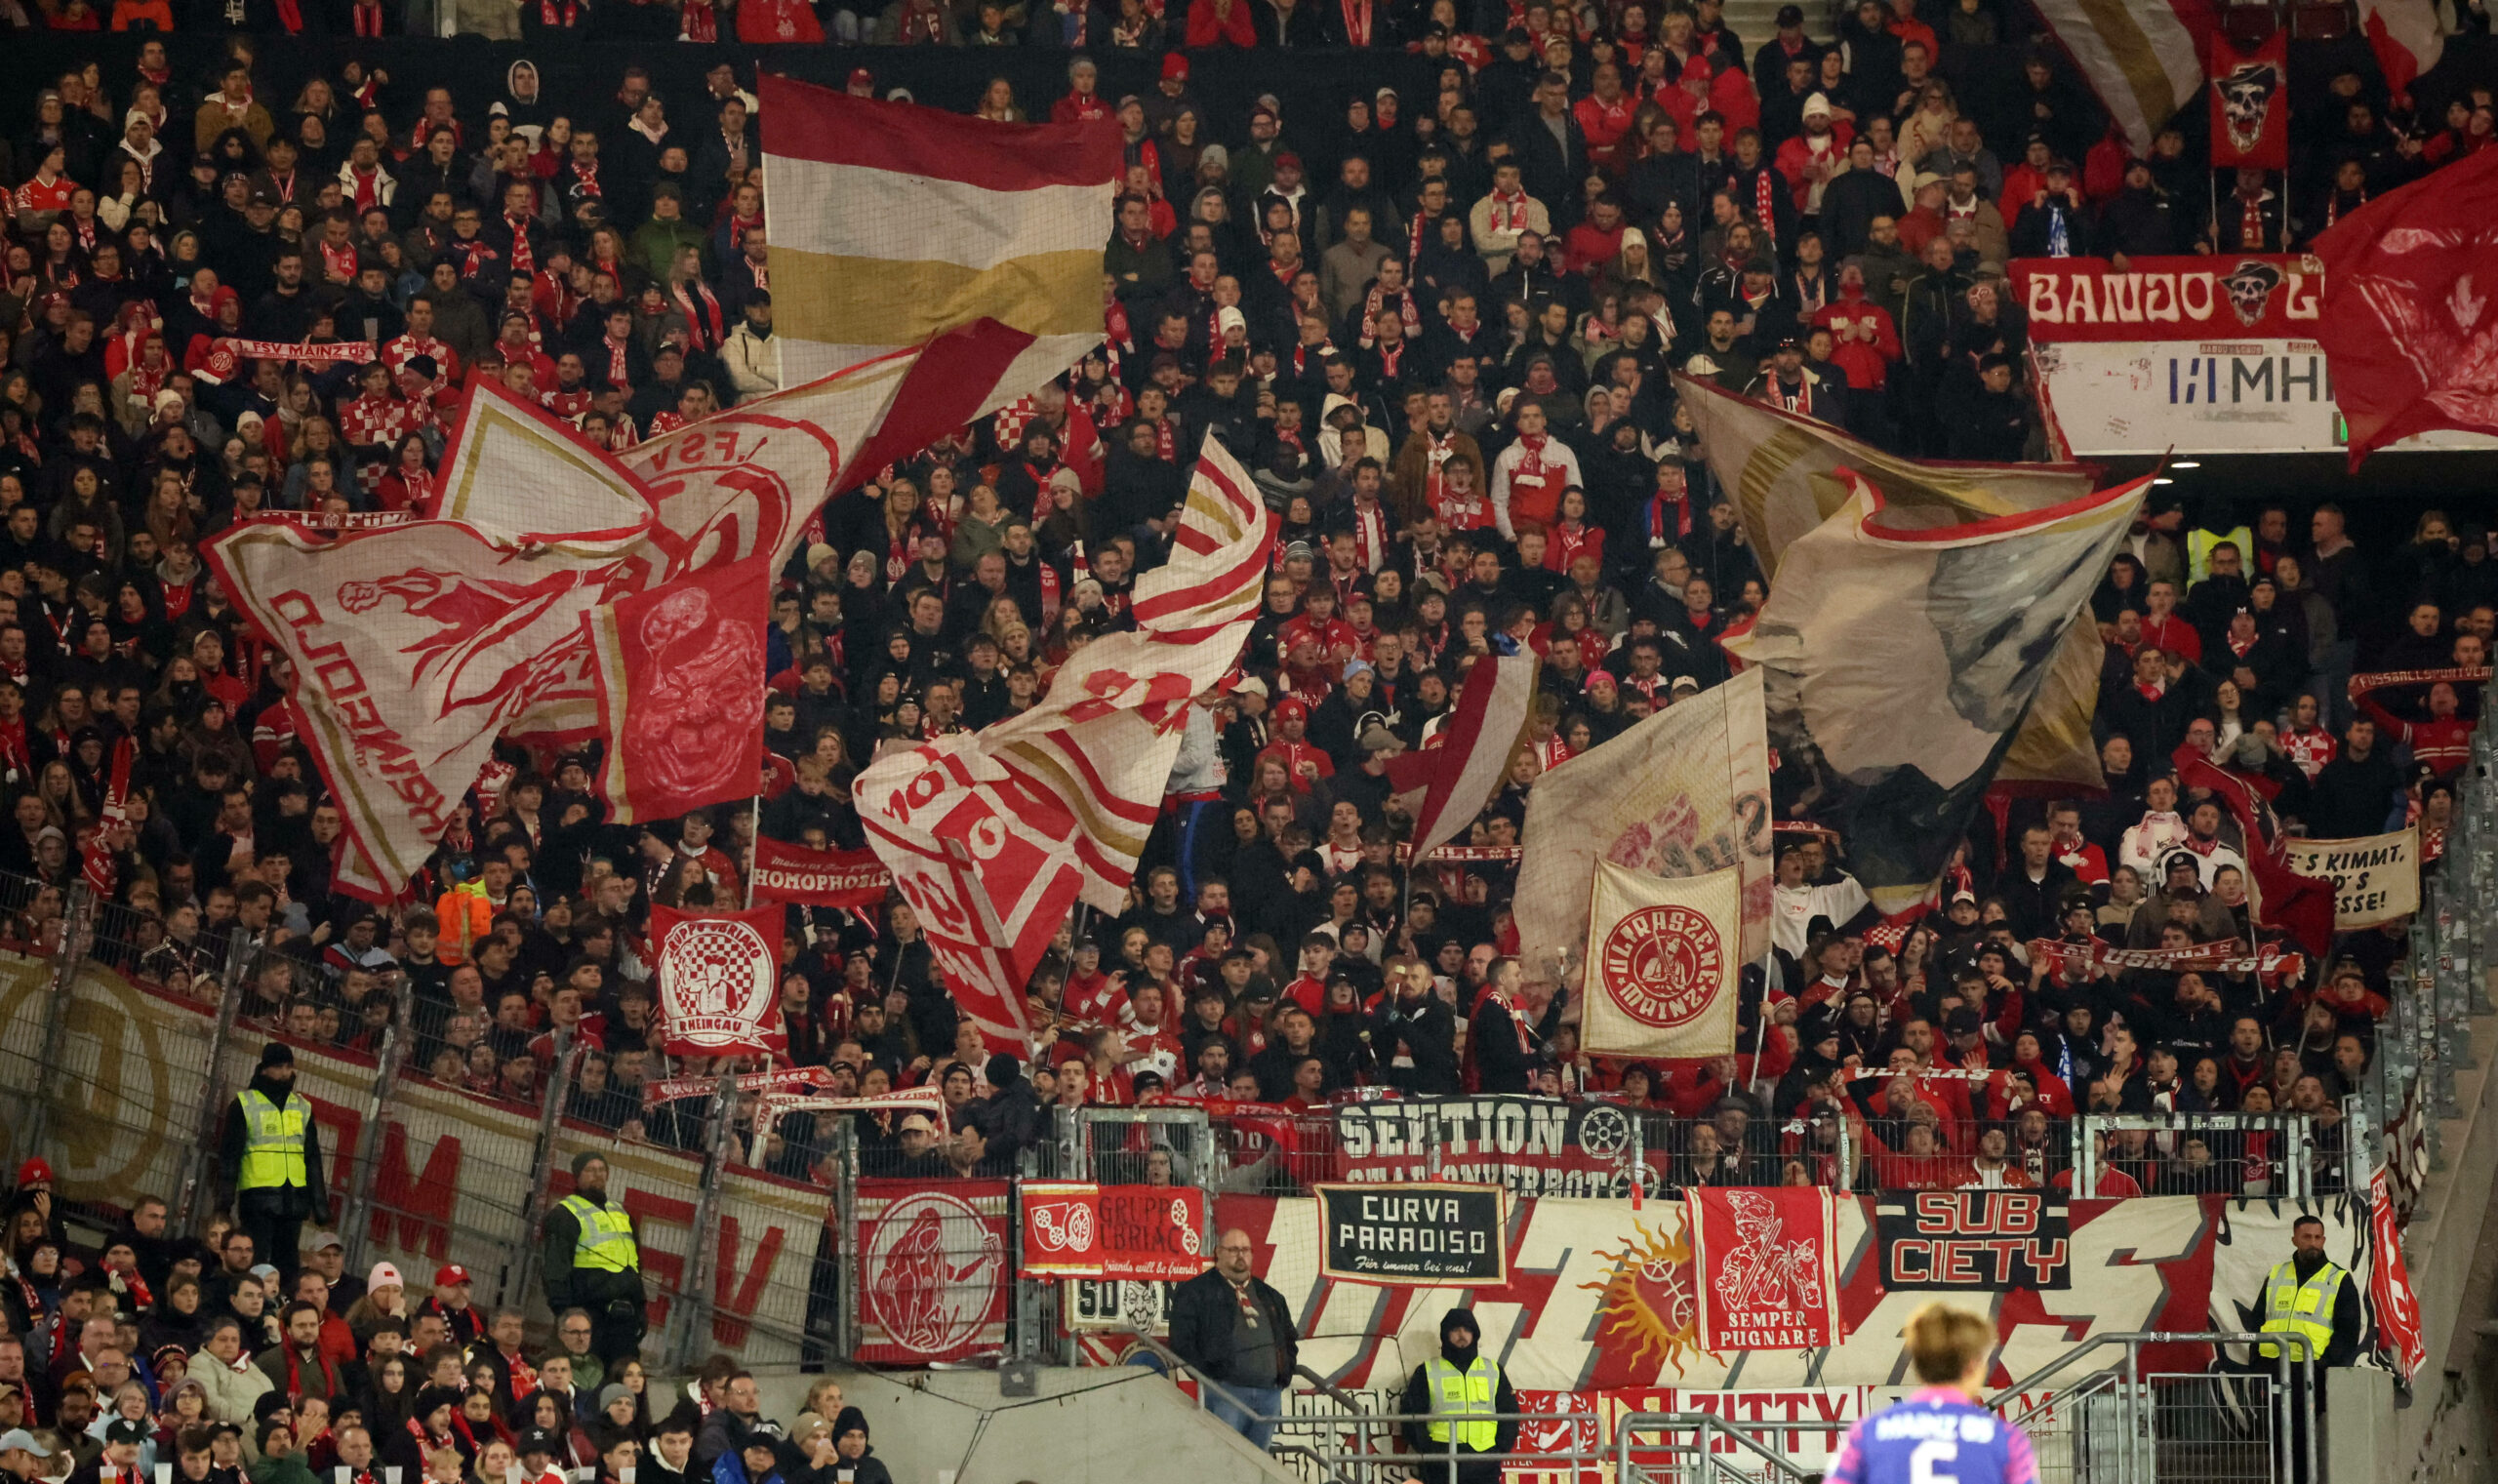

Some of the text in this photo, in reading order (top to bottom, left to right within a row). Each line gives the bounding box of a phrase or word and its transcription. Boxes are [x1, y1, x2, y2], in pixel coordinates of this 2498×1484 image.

[253, 342, 285, 354] FSV
[289, 344, 342, 357] MAINZ
[2325, 844, 2405, 872] KIMMT,
[752, 868, 891, 891] HOMOPHOBIE
[1609, 911, 1719, 984] ULTRASZENE
[1619, 982, 1703, 1020] MAINZ
[678, 1018, 743, 1034] RHEINGAU
[1340, 1101, 1570, 1159] SEKTION
[1362, 1195, 1460, 1223] CURVA
[1915, 1192, 2041, 1234] SUB
[1340, 1223, 1486, 1255] PARADISO
[1105, 1259, 1198, 1278] friends will be friends
[1353, 1256, 1380, 1270] Für
[1382, 1260, 1420, 1271] immer
[1424, 1260, 1441, 1272] bei
[1891, 1238, 2069, 1284] CIETY
[1728, 1309, 1808, 1329] SEMPER
[1720, 1328, 1819, 1346] PUGNARE
[1689, 1392, 1849, 1454] ZITTY
[1875, 1411, 1958, 1441] MAINZ
